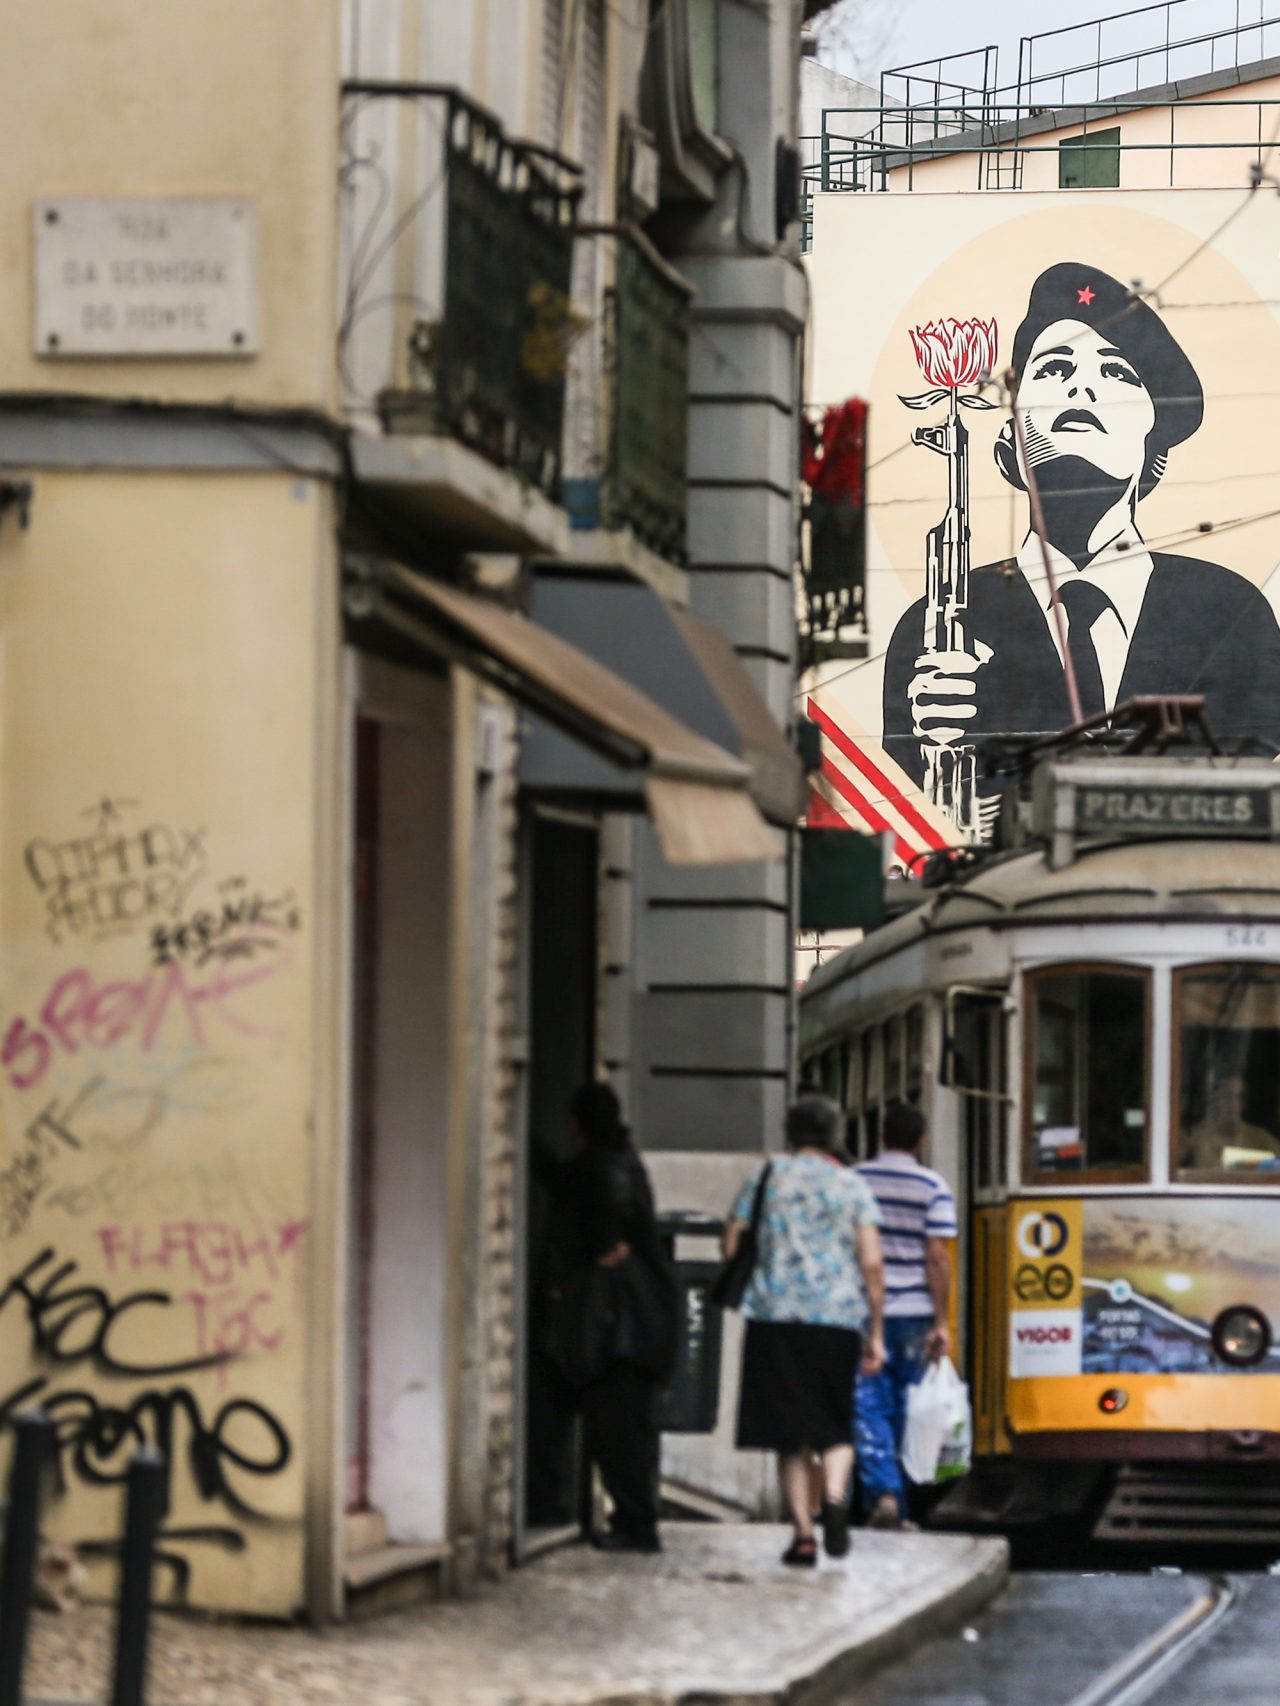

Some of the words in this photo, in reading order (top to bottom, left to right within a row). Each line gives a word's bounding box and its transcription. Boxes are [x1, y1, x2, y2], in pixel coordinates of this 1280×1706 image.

[1084, 792, 1254, 822] PRAZERES
[1225, 926, 1267, 947] 544
[1016, 1325, 1073, 1345] VIGOR
